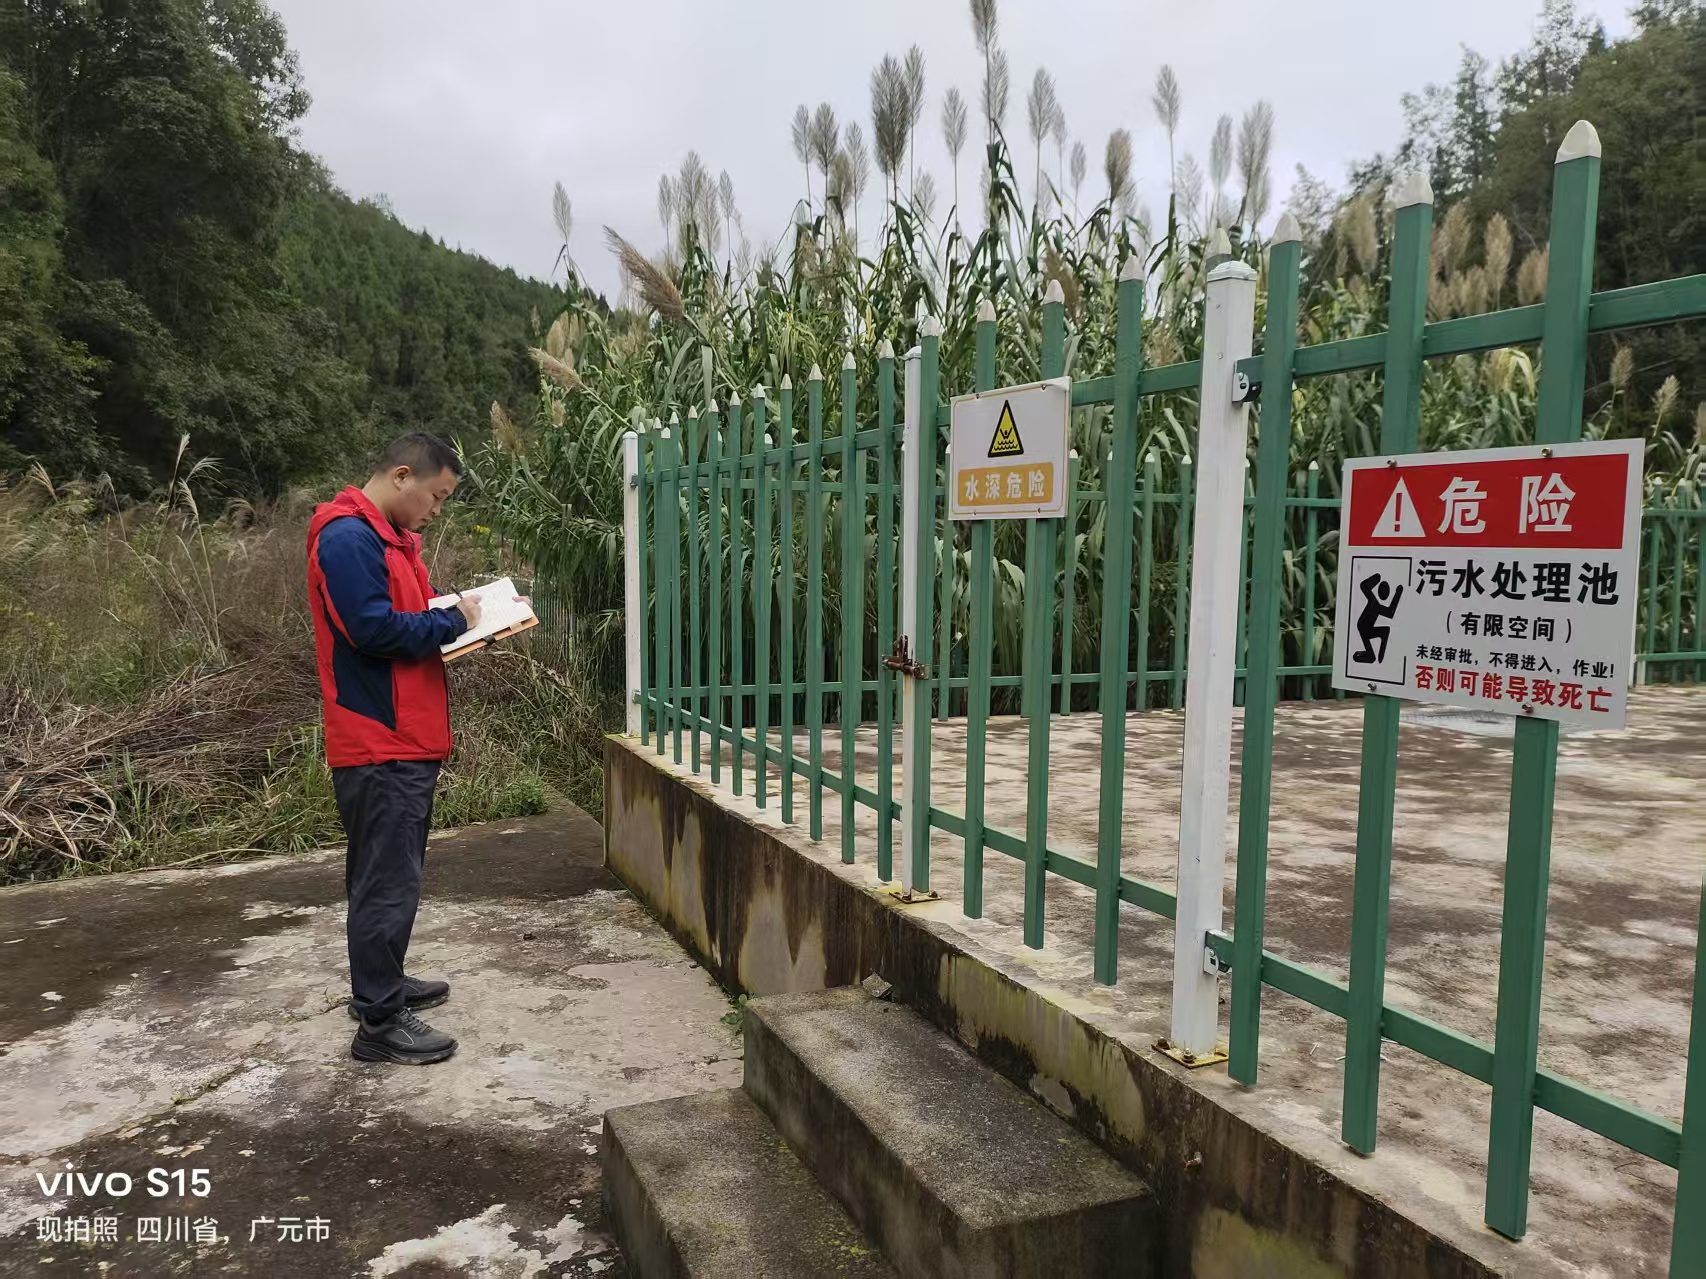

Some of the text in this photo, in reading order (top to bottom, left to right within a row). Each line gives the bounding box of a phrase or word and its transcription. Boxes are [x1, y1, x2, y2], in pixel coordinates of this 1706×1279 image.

[964, 469, 1045, 501] 水深危险
[1437, 472, 1577, 535] 危险
[1415, 559, 1620, 606] 污水处理池
[1446, 610, 1572, 644] （有限空间）
[1414, 664, 1614, 713] 否则可能导致死亡
